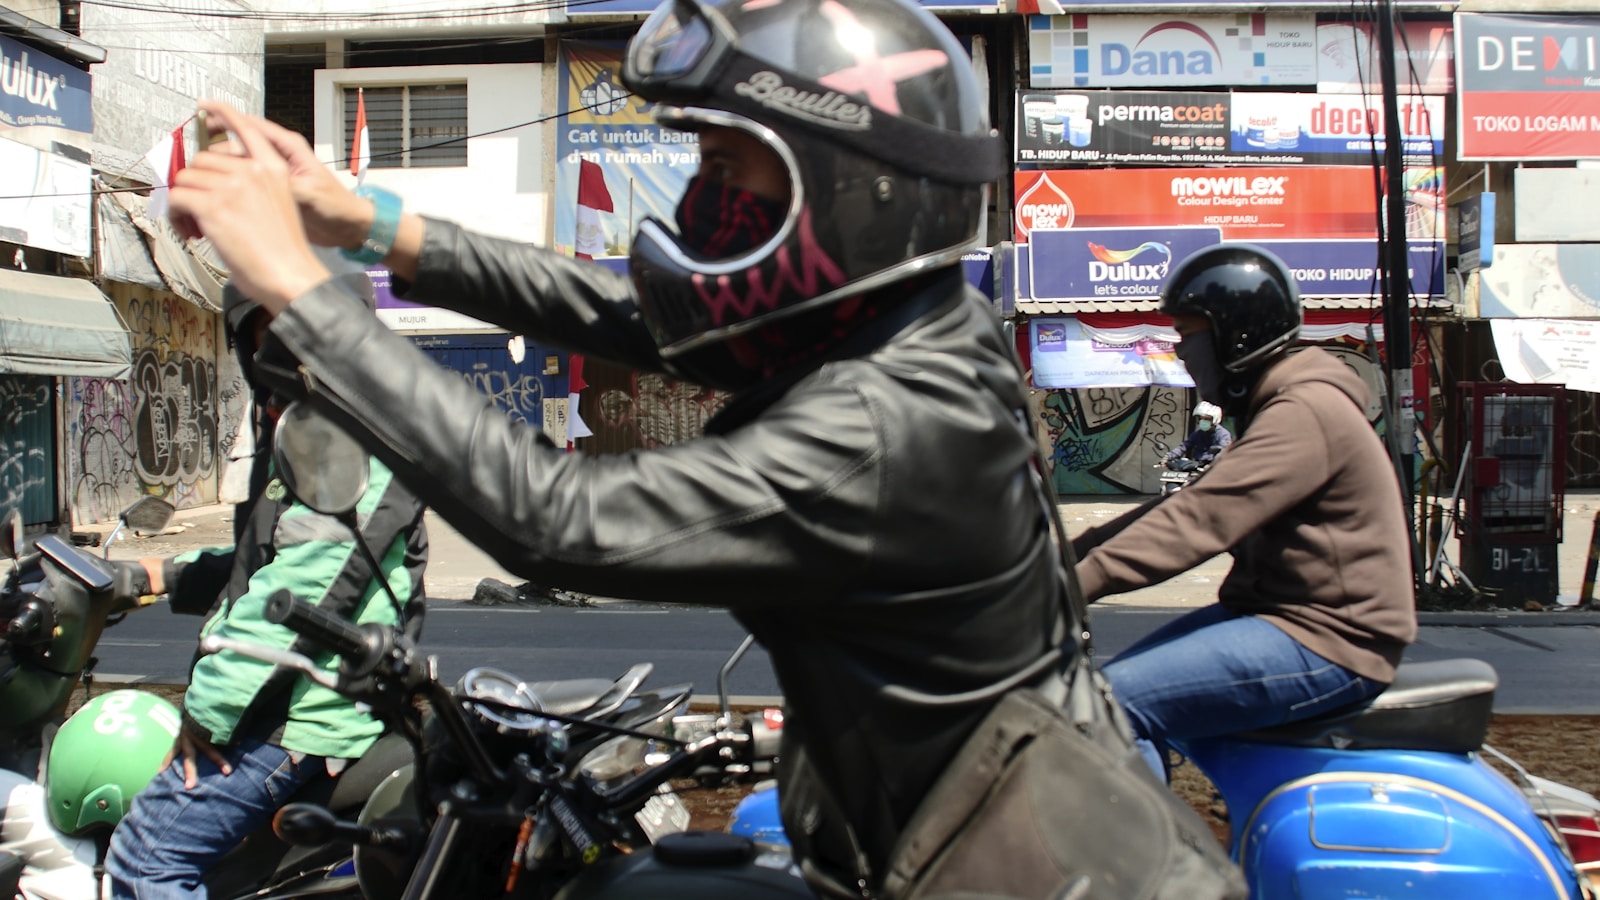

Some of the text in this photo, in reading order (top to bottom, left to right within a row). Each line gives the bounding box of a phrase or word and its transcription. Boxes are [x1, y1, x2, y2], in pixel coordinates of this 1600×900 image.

[1279, 31, 1300, 39] TOKO
[1101, 43, 1212, 76] Dana
[134, 37, 208, 100] LORENT
[0, 48, 58, 111] ulux
[1098, 102, 1224, 126] permacoat
[1311, 102, 1432, 136] decoth
[1473, 116, 1520, 132] TOKO
[1525, 116, 1587, 132] LOGAM
[568, 129, 598, 143] Cat
[603, 128, 654, 143] untuk
[568, 149, 599, 163] dan
[605, 150, 663, 164] rumah
[1021, 150, 1037, 160] TB.
[1037, 150, 1070, 160] HIDUP
[1071, 150, 1099, 161] BARU
[1177, 197, 1284, 208] Colour Design Center
[1203, 216, 1258, 224] HIDUP BARU
[1089, 262, 1162, 281] Dulux
[1288, 269, 1326, 281] TOKO
[1329, 269, 1374, 281] HIDUP
[1094, 285, 1159, 296] let's colour
[399, 316, 427, 324] MUJUR
[1039, 334, 1063, 342] Dulux
